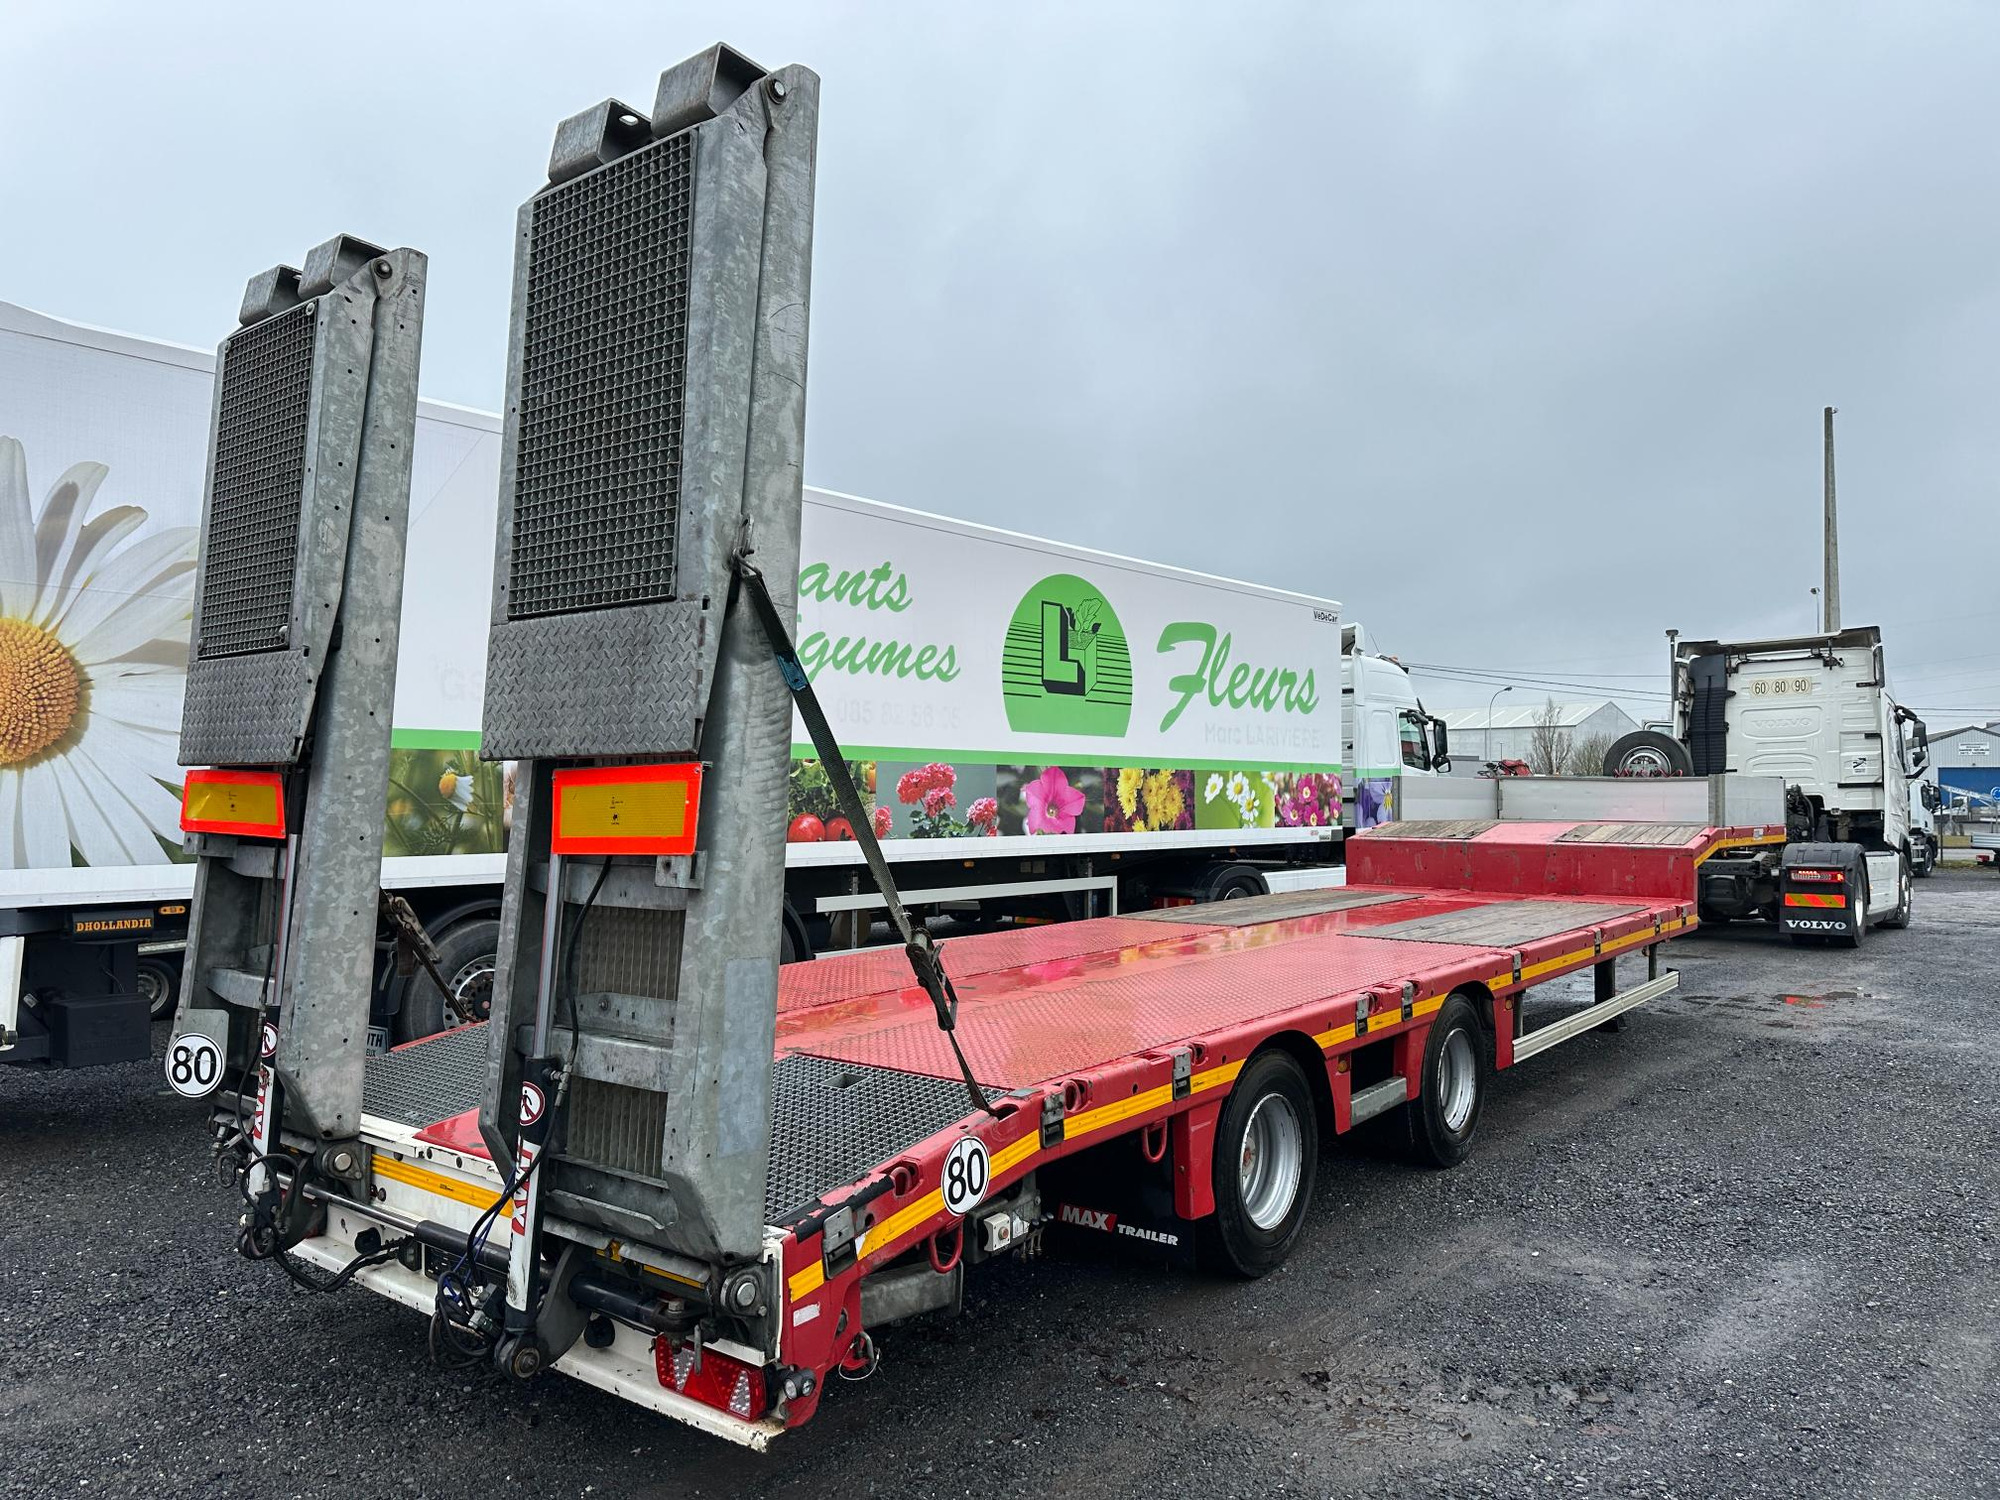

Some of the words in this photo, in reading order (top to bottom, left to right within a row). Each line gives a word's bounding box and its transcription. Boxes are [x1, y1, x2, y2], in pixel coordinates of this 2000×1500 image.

[797, 616, 961, 683] gumes
[1156, 621, 1320, 733] Fleurs
[1774, 680, 1786, 693] 80
[1794, 679, 1807, 692] 90
[1754, 682, 1767, 695] 60
[1203, 721, 1242, 745] Marc
[1751, 718, 1812, 729] VOLVO
[76, 918, 152, 932] DHOLLANDIA
[1785, 919, 1847, 930] VOLVO
[171, 1045, 217, 1085] 80
[948, 1148, 985, 1205] 80
[1062, 1204, 1109, 1231] MAX
[1117, 1223, 1179, 1246] TRAILER
